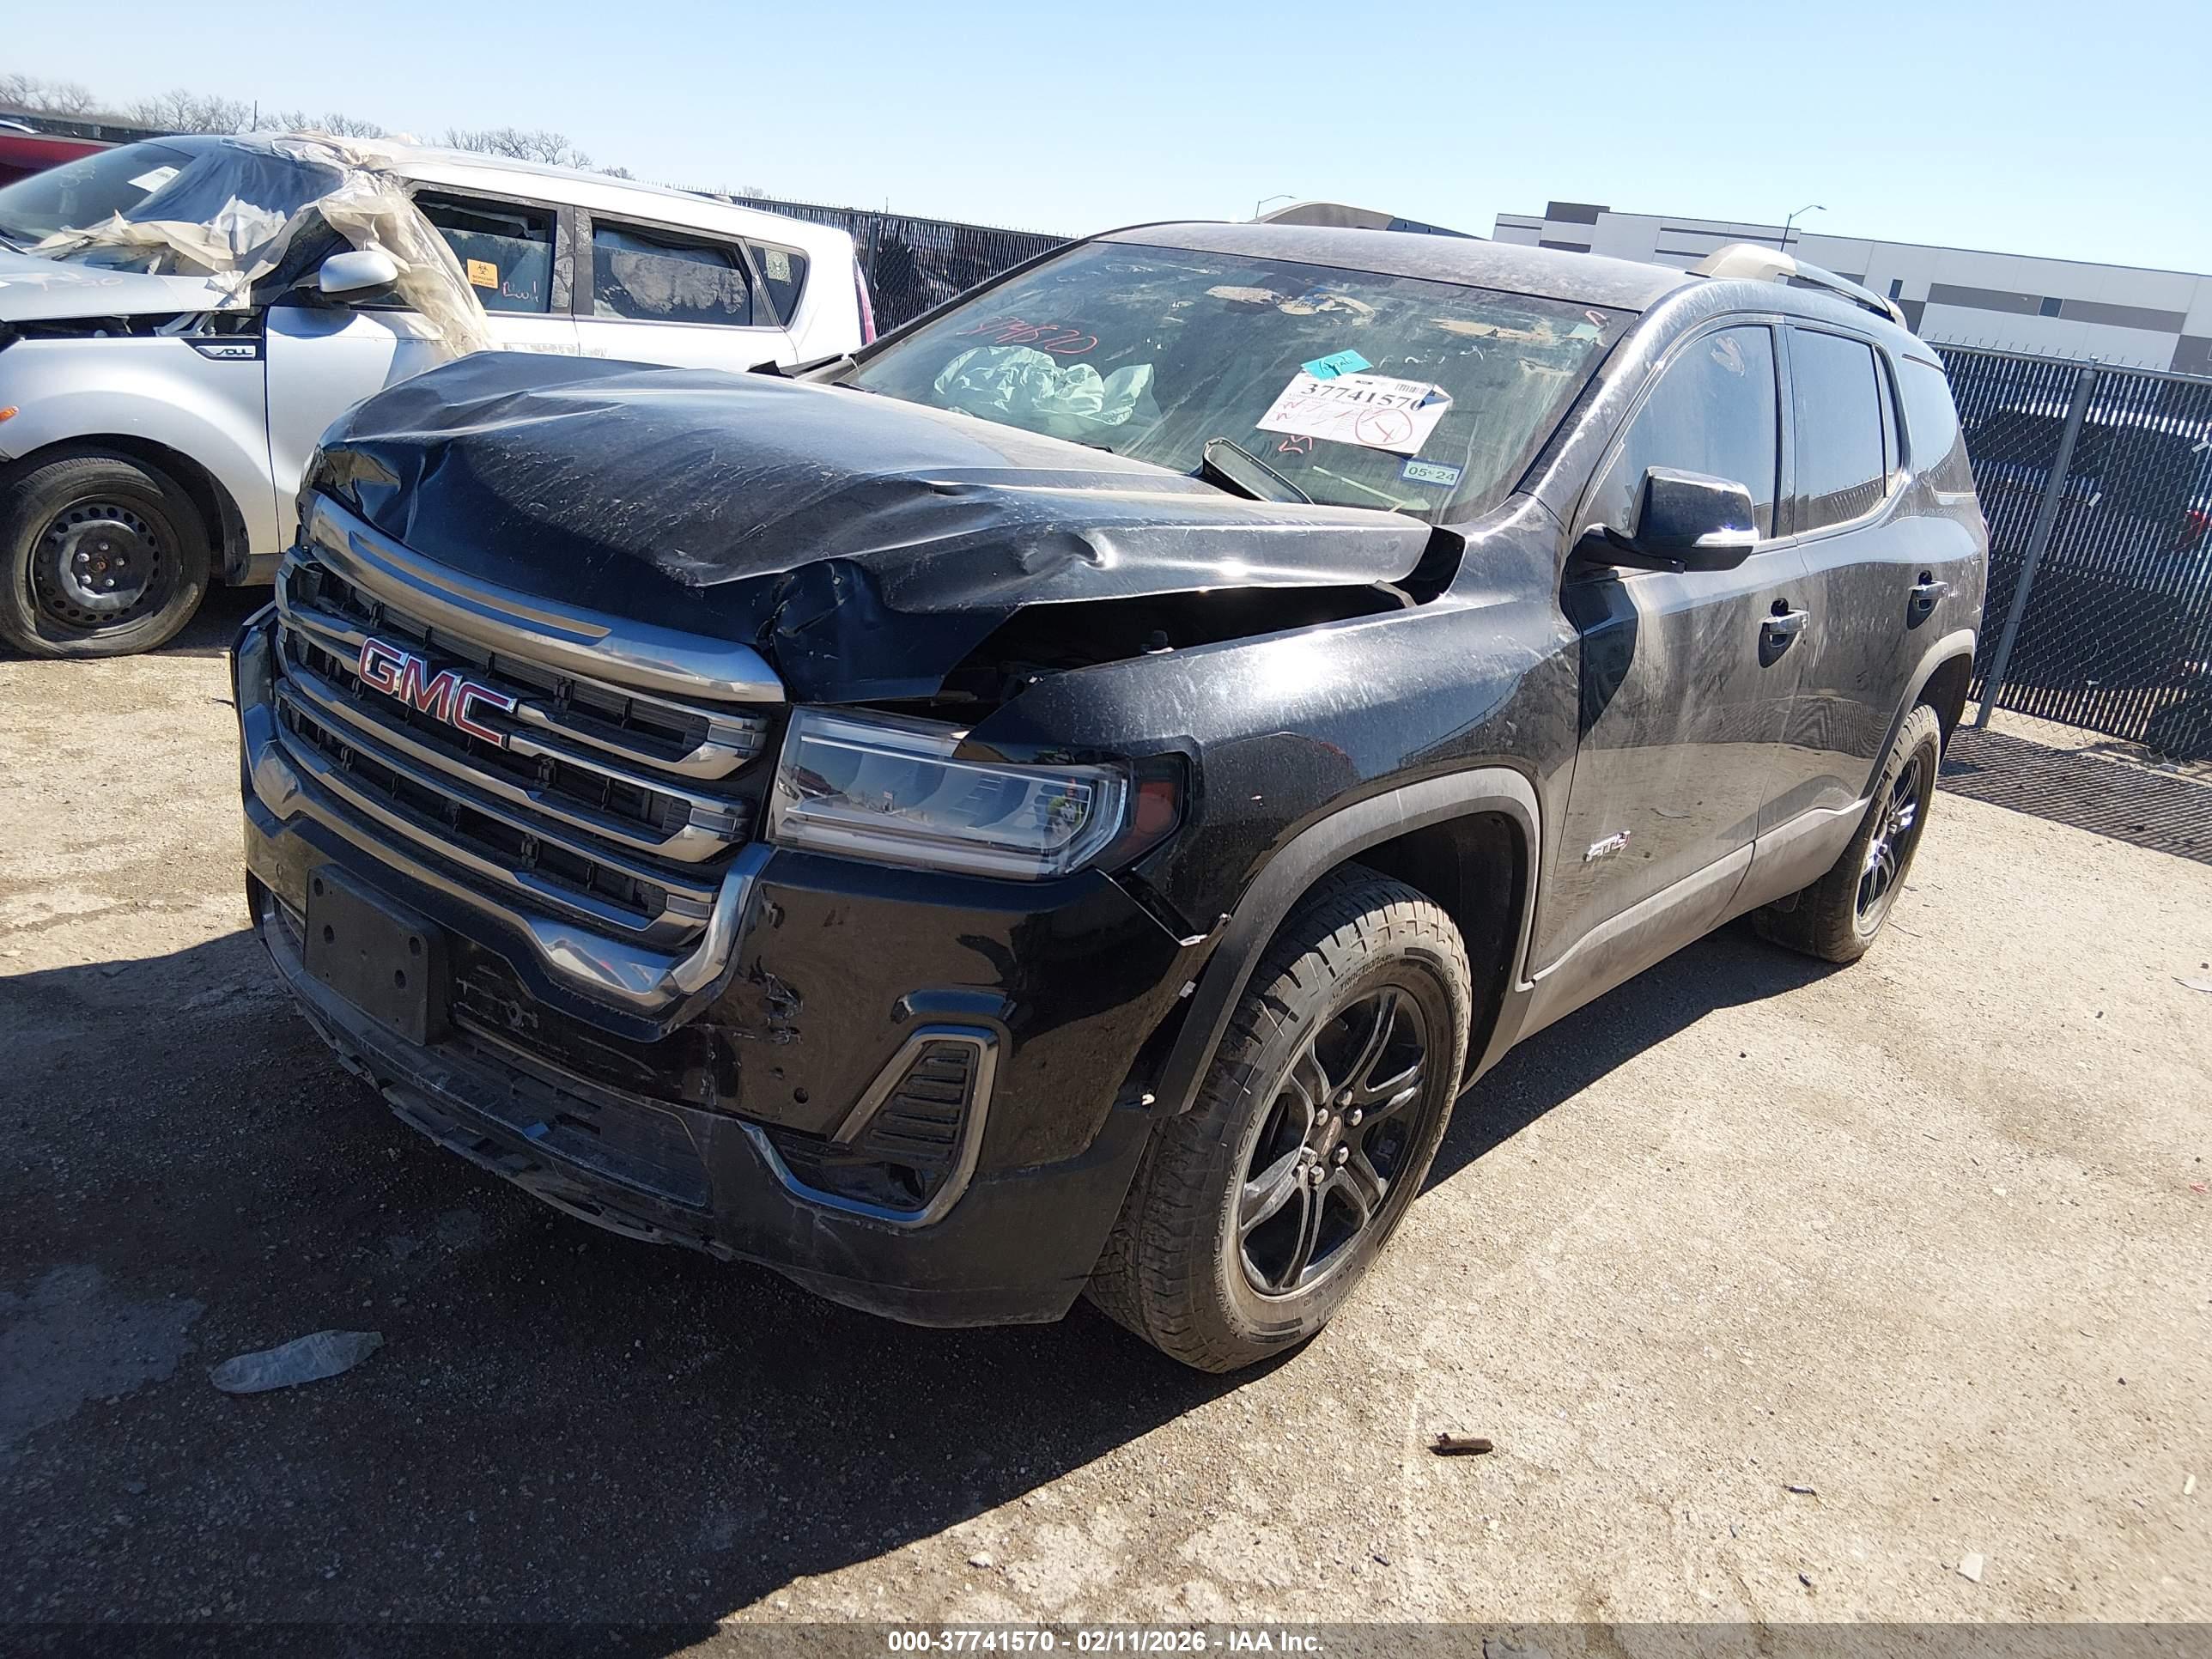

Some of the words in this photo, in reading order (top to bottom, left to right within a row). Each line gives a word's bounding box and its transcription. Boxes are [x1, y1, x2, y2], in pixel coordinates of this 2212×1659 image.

[1408, 466, 1427, 477] 05
[1435, 471, 1455, 481] 24
[358, 637, 518, 750] GMC
